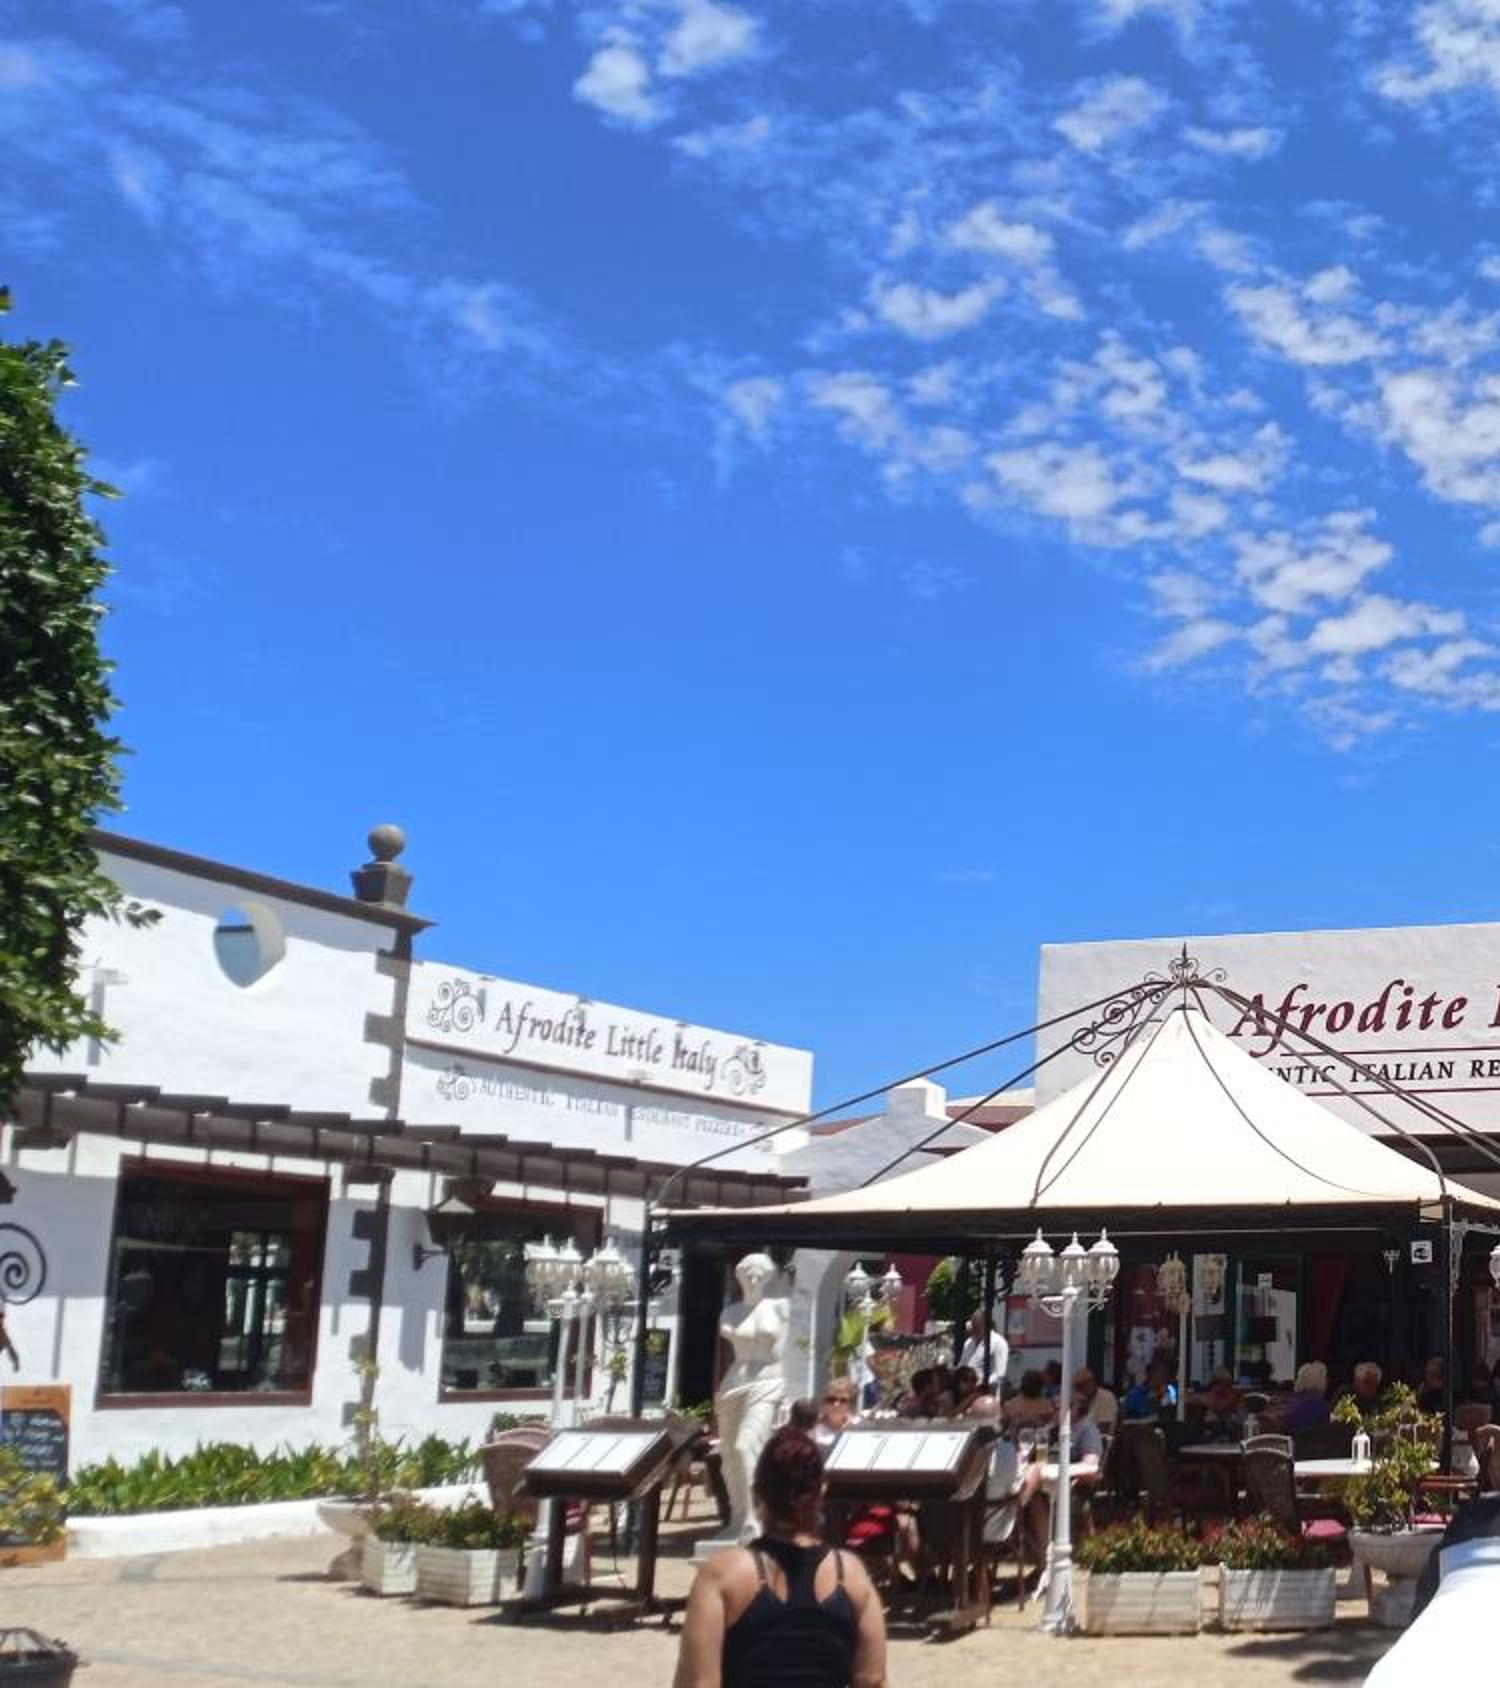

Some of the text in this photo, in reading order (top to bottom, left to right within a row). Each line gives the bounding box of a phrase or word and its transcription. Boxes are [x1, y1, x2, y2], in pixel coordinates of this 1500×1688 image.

[496, 1001, 718, 1090] Afrodite Little Italy
[1226, 979, 1467, 1058] Afrodite
[1268, 1065, 1335, 1083] NTIC
[1350, 1061, 1455, 1082] ITALIAN
